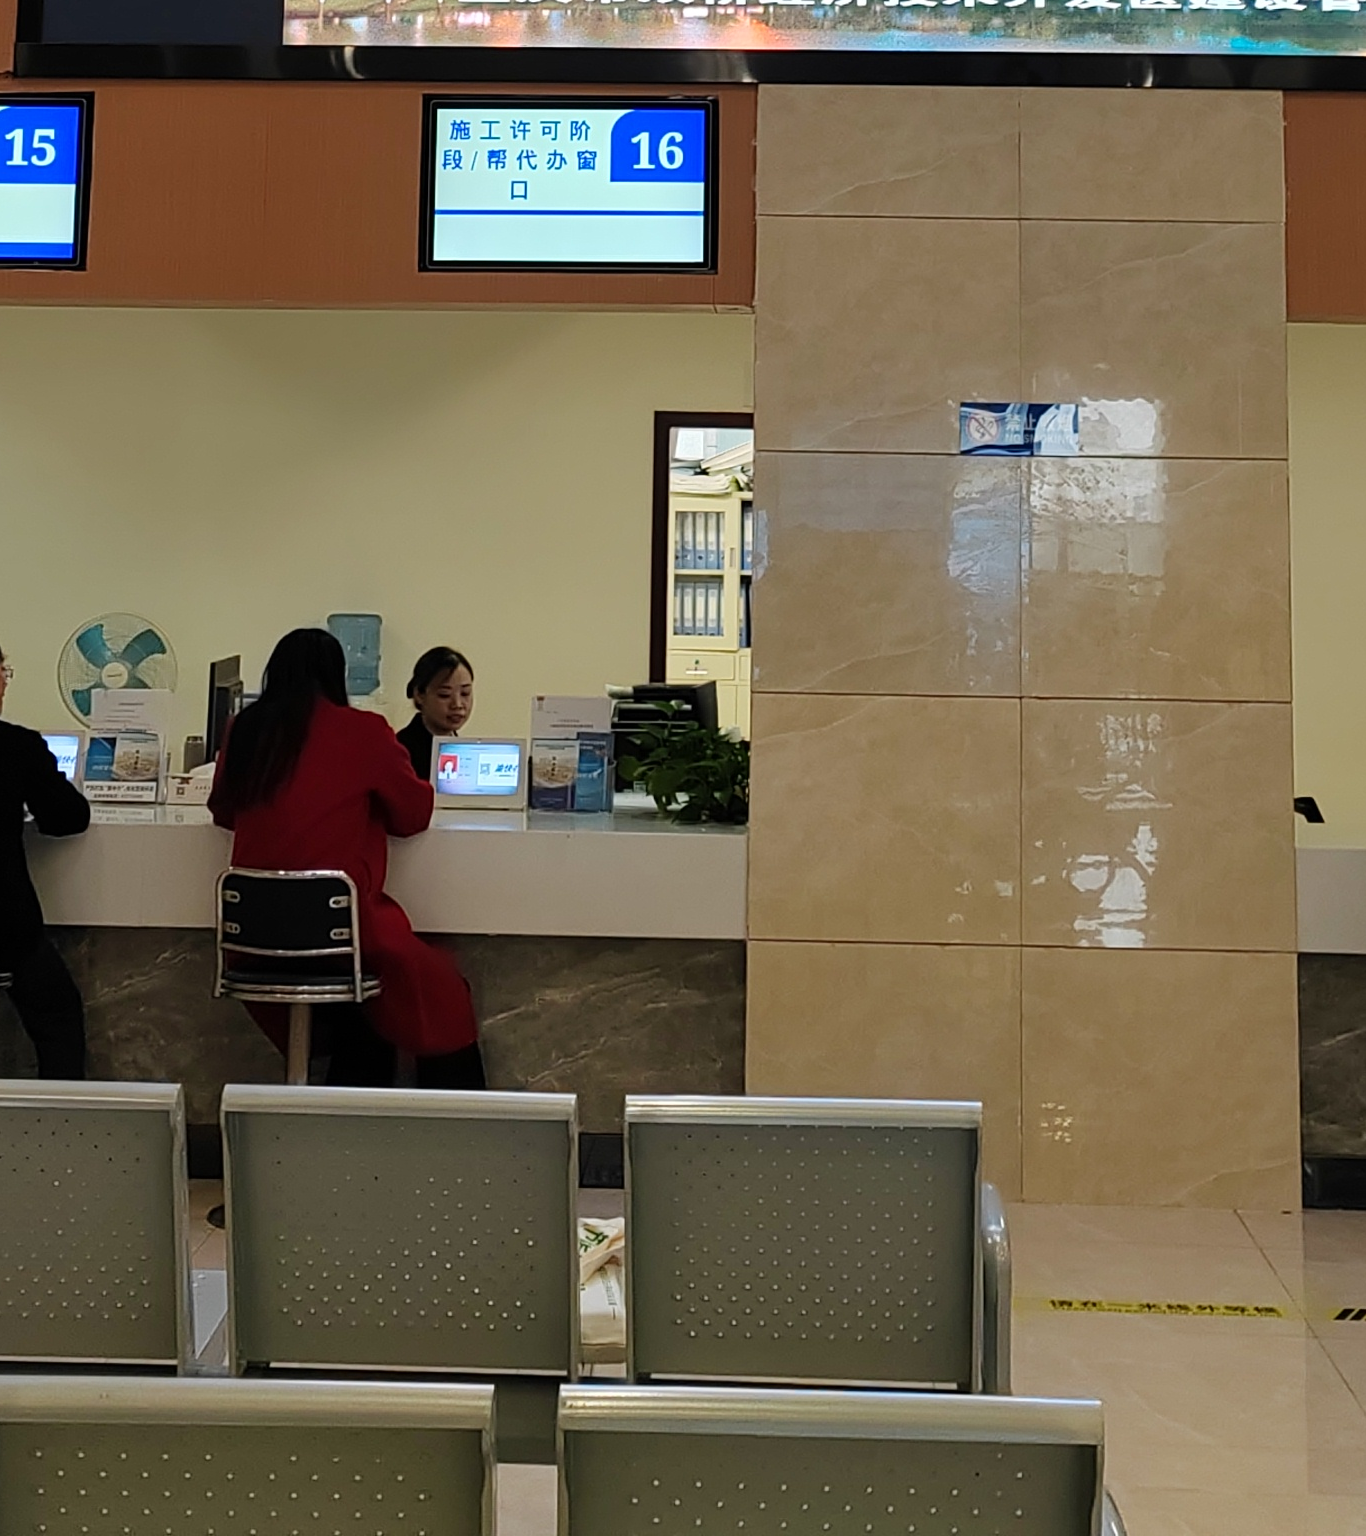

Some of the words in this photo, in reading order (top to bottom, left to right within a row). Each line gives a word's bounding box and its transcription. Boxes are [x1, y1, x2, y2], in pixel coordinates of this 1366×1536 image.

[449, 119, 591, 142] 施工许可阶
[4, 128, 57, 166] 15
[630, 131, 685, 170] 16
[442, 149, 598, 172] 段/帮代办窗
[510, 180, 528, 200] 口
